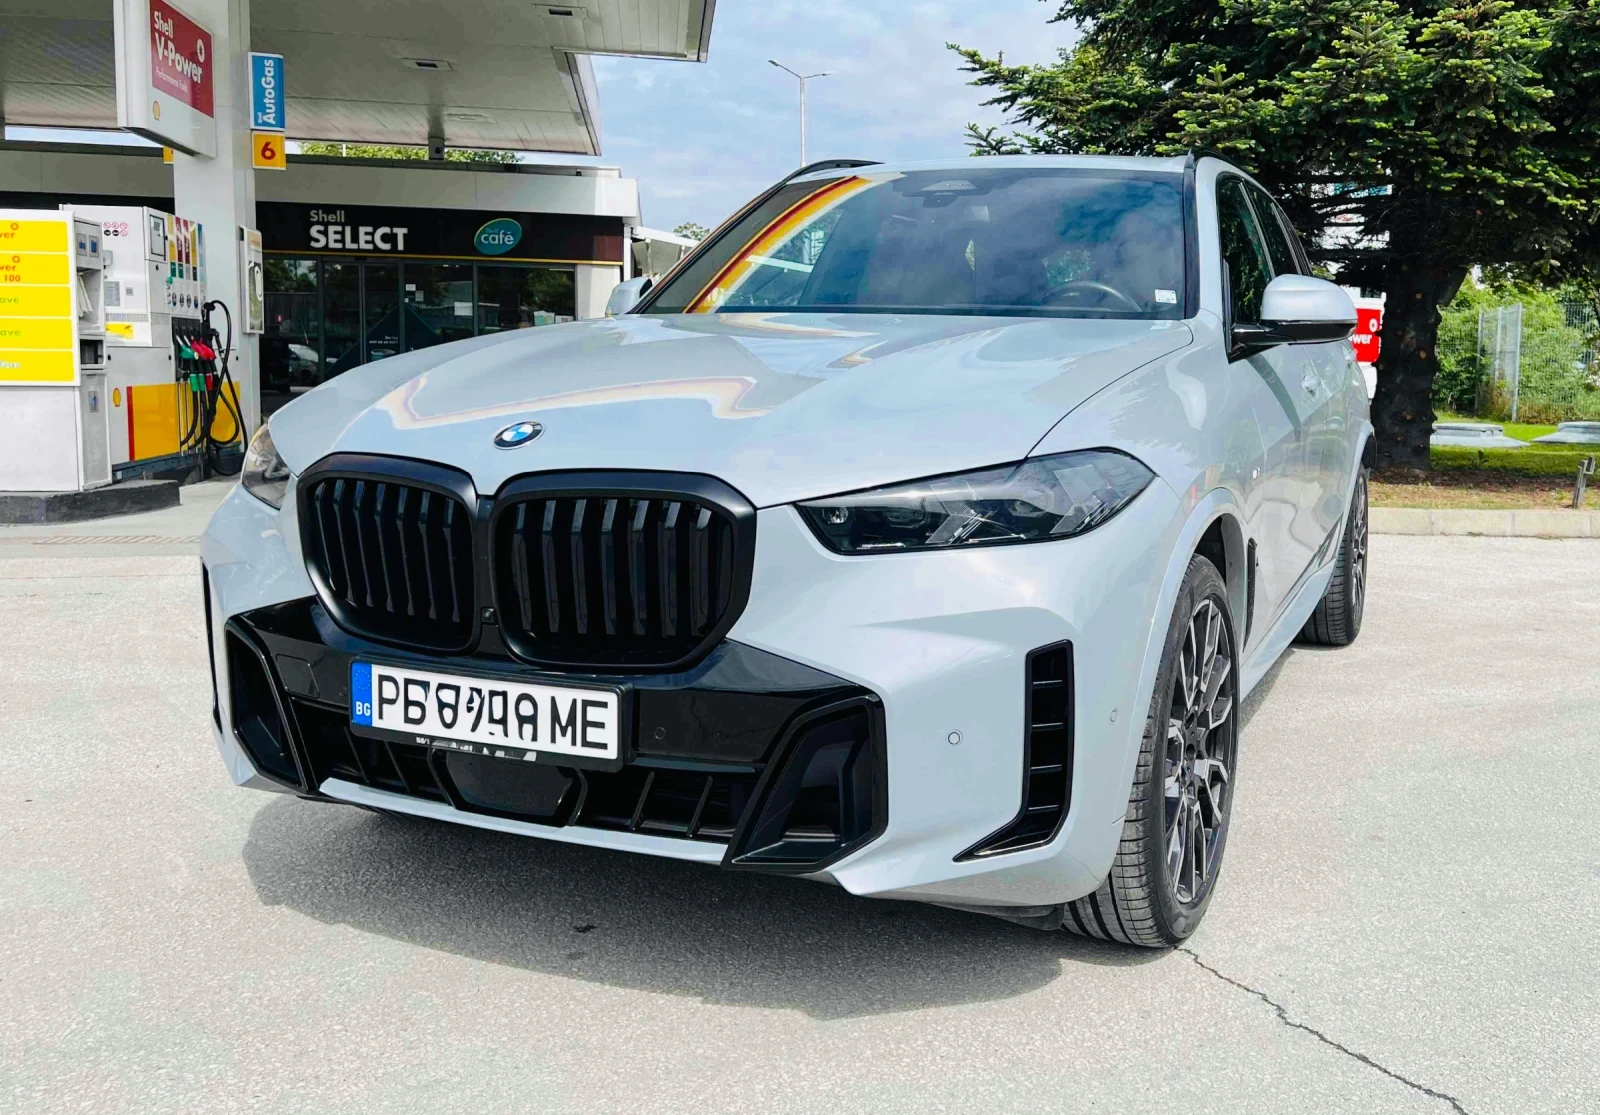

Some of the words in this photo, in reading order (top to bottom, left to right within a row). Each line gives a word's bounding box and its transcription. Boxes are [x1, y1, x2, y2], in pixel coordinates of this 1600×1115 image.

[153, 10, 174, 39] Shell
[154, 31, 203, 84] V-Power
[261, 59, 276, 125] AutoGas
[261, 141, 276, 160] 6
[309, 209, 345, 223] Shell
[309, 224, 408, 251] SELECT
[480, 229, 514, 245] café
[4, 274, 21, 282] 100
[355, 700, 371, 717] BG
